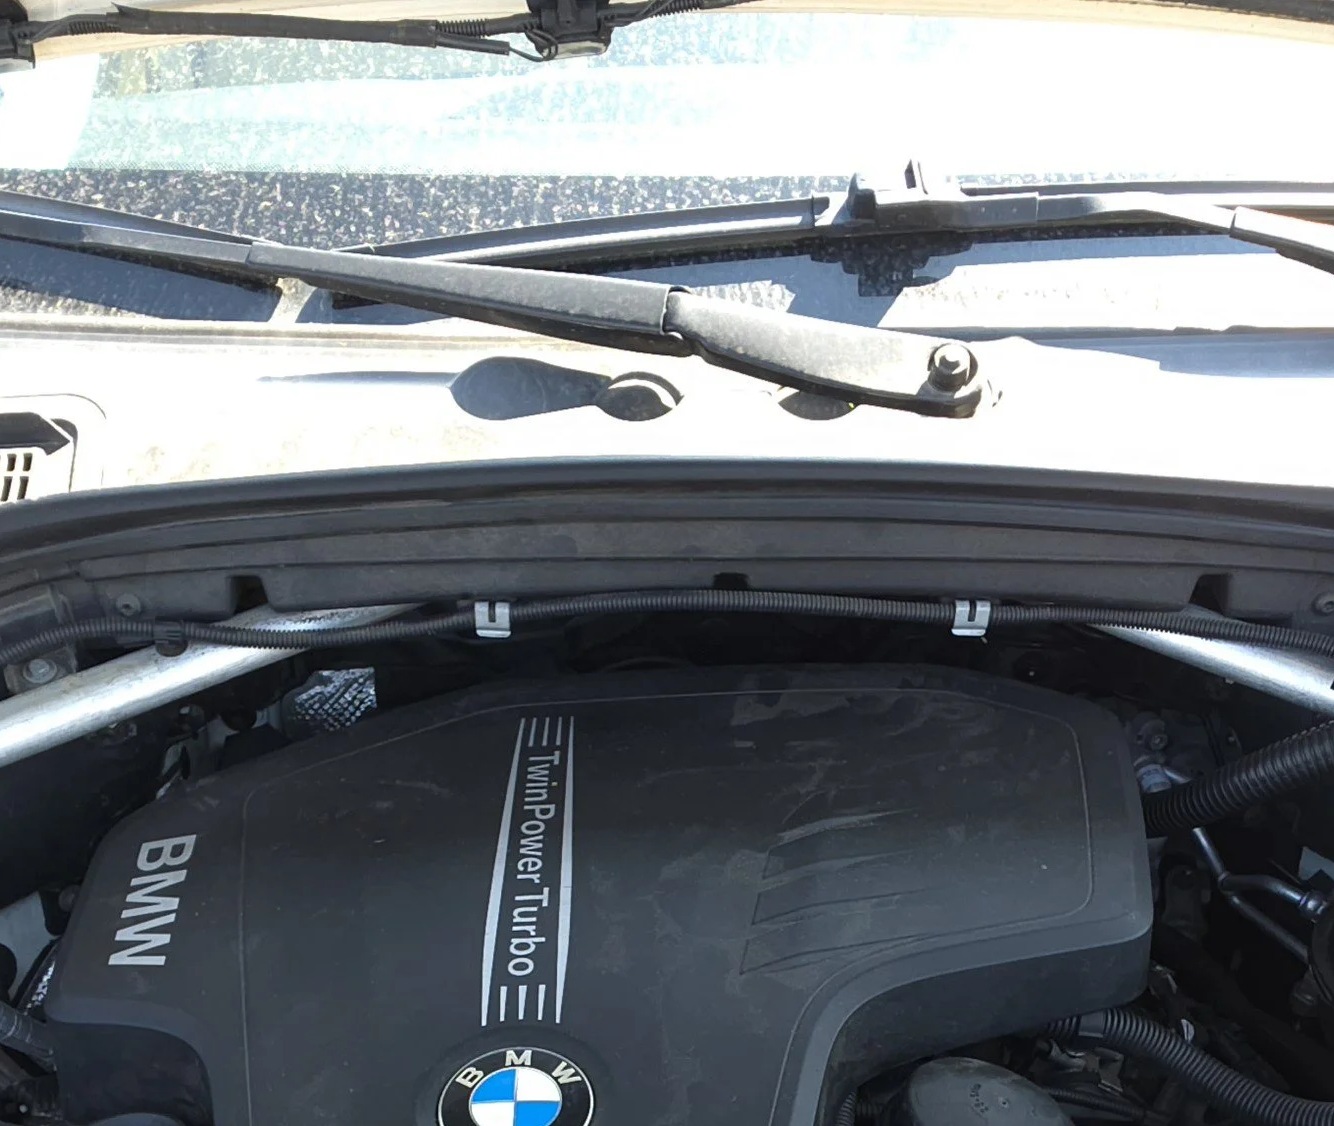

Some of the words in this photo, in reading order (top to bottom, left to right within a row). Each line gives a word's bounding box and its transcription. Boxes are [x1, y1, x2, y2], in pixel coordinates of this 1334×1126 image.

[516, 750, 561, 884] TwinPower
[108, 834, 197, 966] BMW
[507, 887, 550, 977] Turbo
[455, 1049, 583, 1090] BMW
